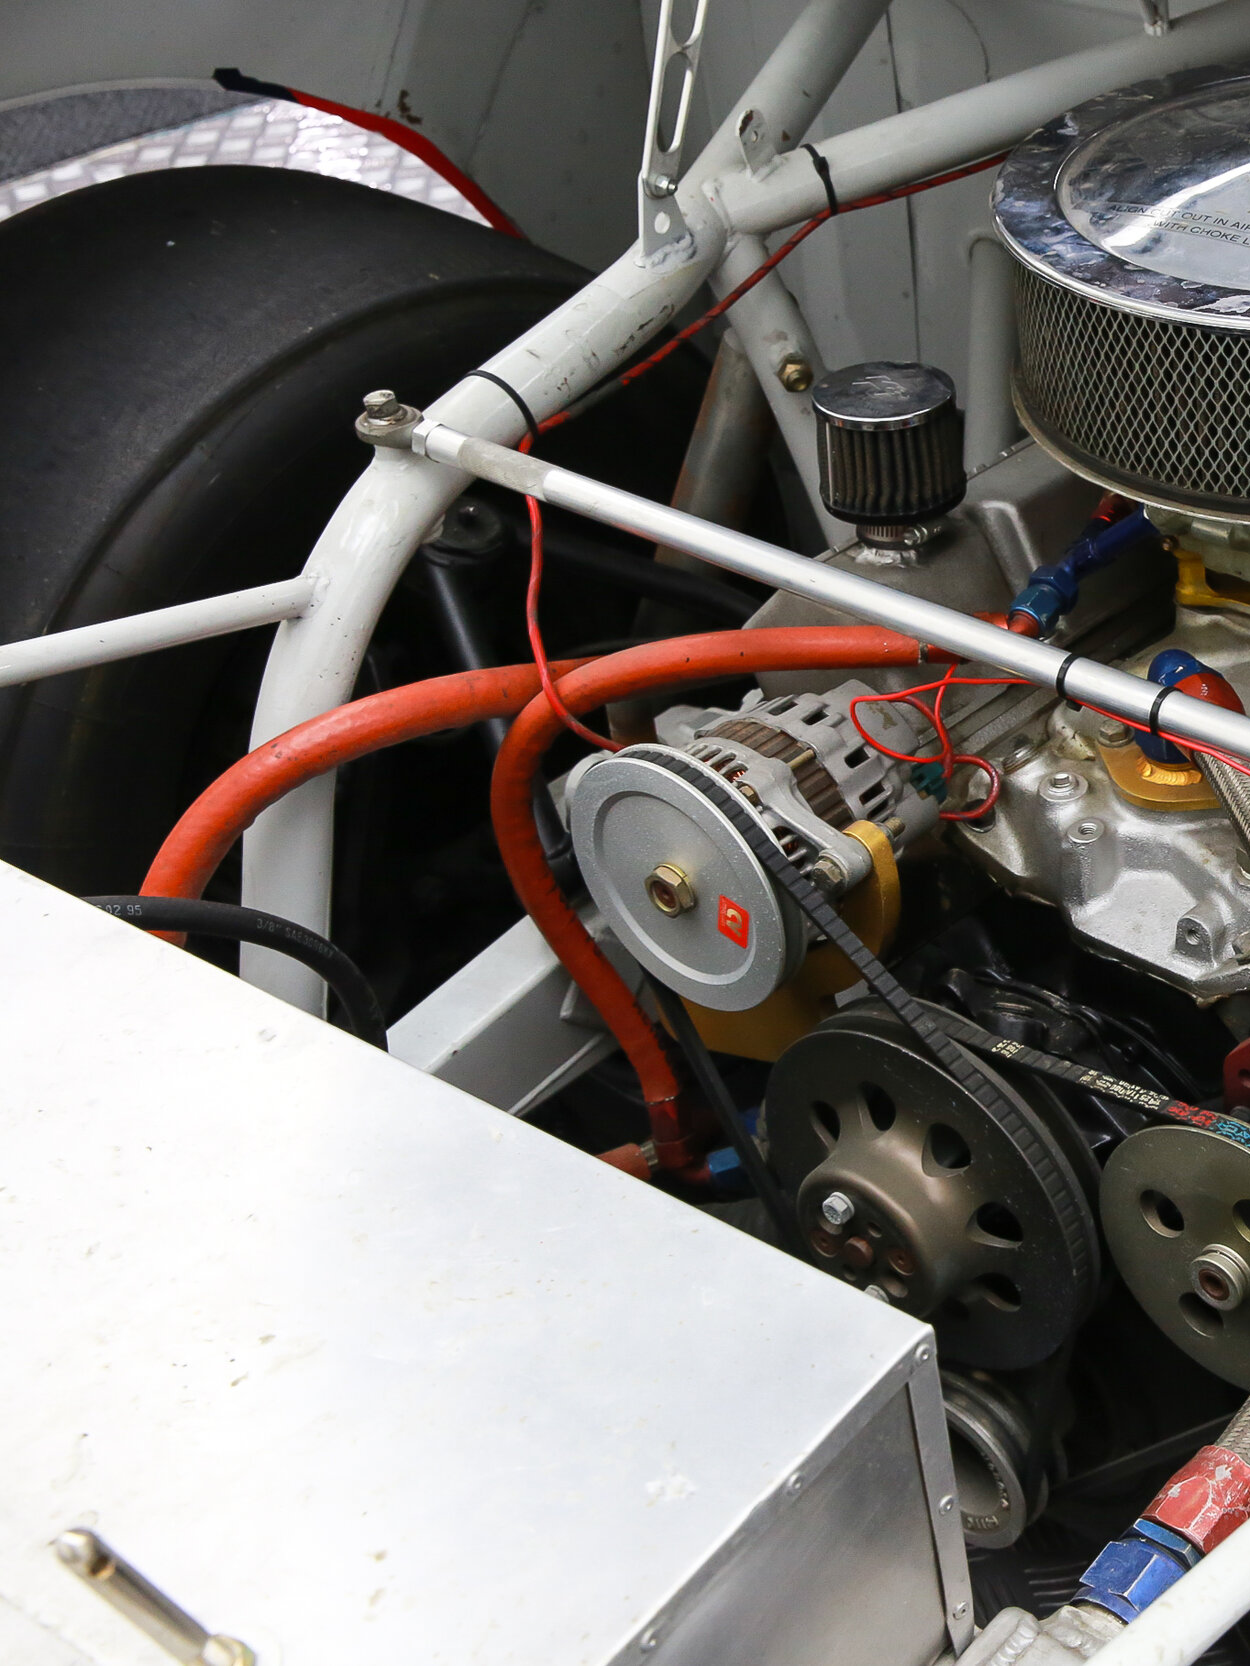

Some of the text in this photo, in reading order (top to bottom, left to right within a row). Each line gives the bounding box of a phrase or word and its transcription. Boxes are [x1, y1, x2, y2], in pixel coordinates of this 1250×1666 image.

[1109, 204, 1147, 214] ALIGN
[1182, 212, 1212, 222] OUT
[1213, 217, 1230, 226] IN
[1154, 221, 1187, 231] WITH
[1190, 226, 1240, 242] CHOKE
[126, 904, 143, 916] 95
